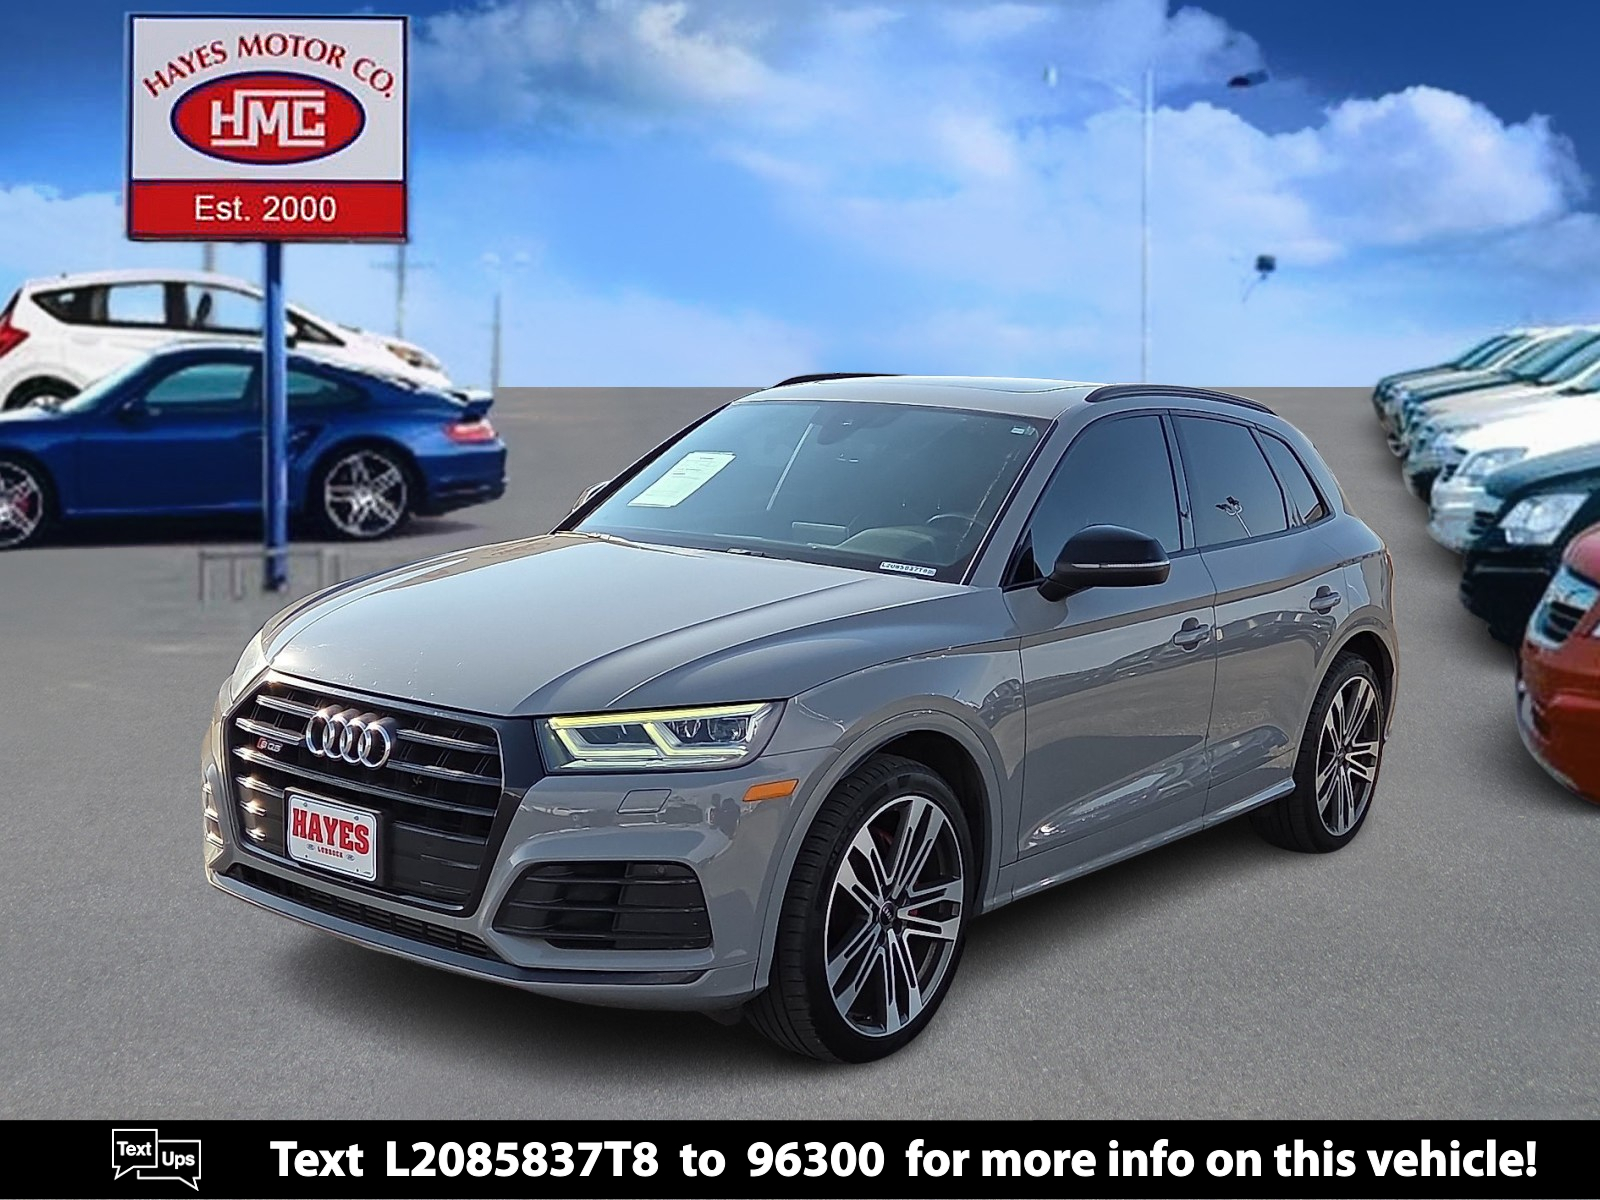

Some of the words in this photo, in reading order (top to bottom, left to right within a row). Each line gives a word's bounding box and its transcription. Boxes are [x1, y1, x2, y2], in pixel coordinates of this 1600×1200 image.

[143, 40, 227, 97] HAYES
[238, 33, 346, 69] MOTOR
[352, 58, 394, 98] CO.
[210, 89, 326, 147] HMC
[195, 195, 250, 221] Est.
[262, 196, 337, 222] 2000
[292, 808, 370, 855] HAYES
